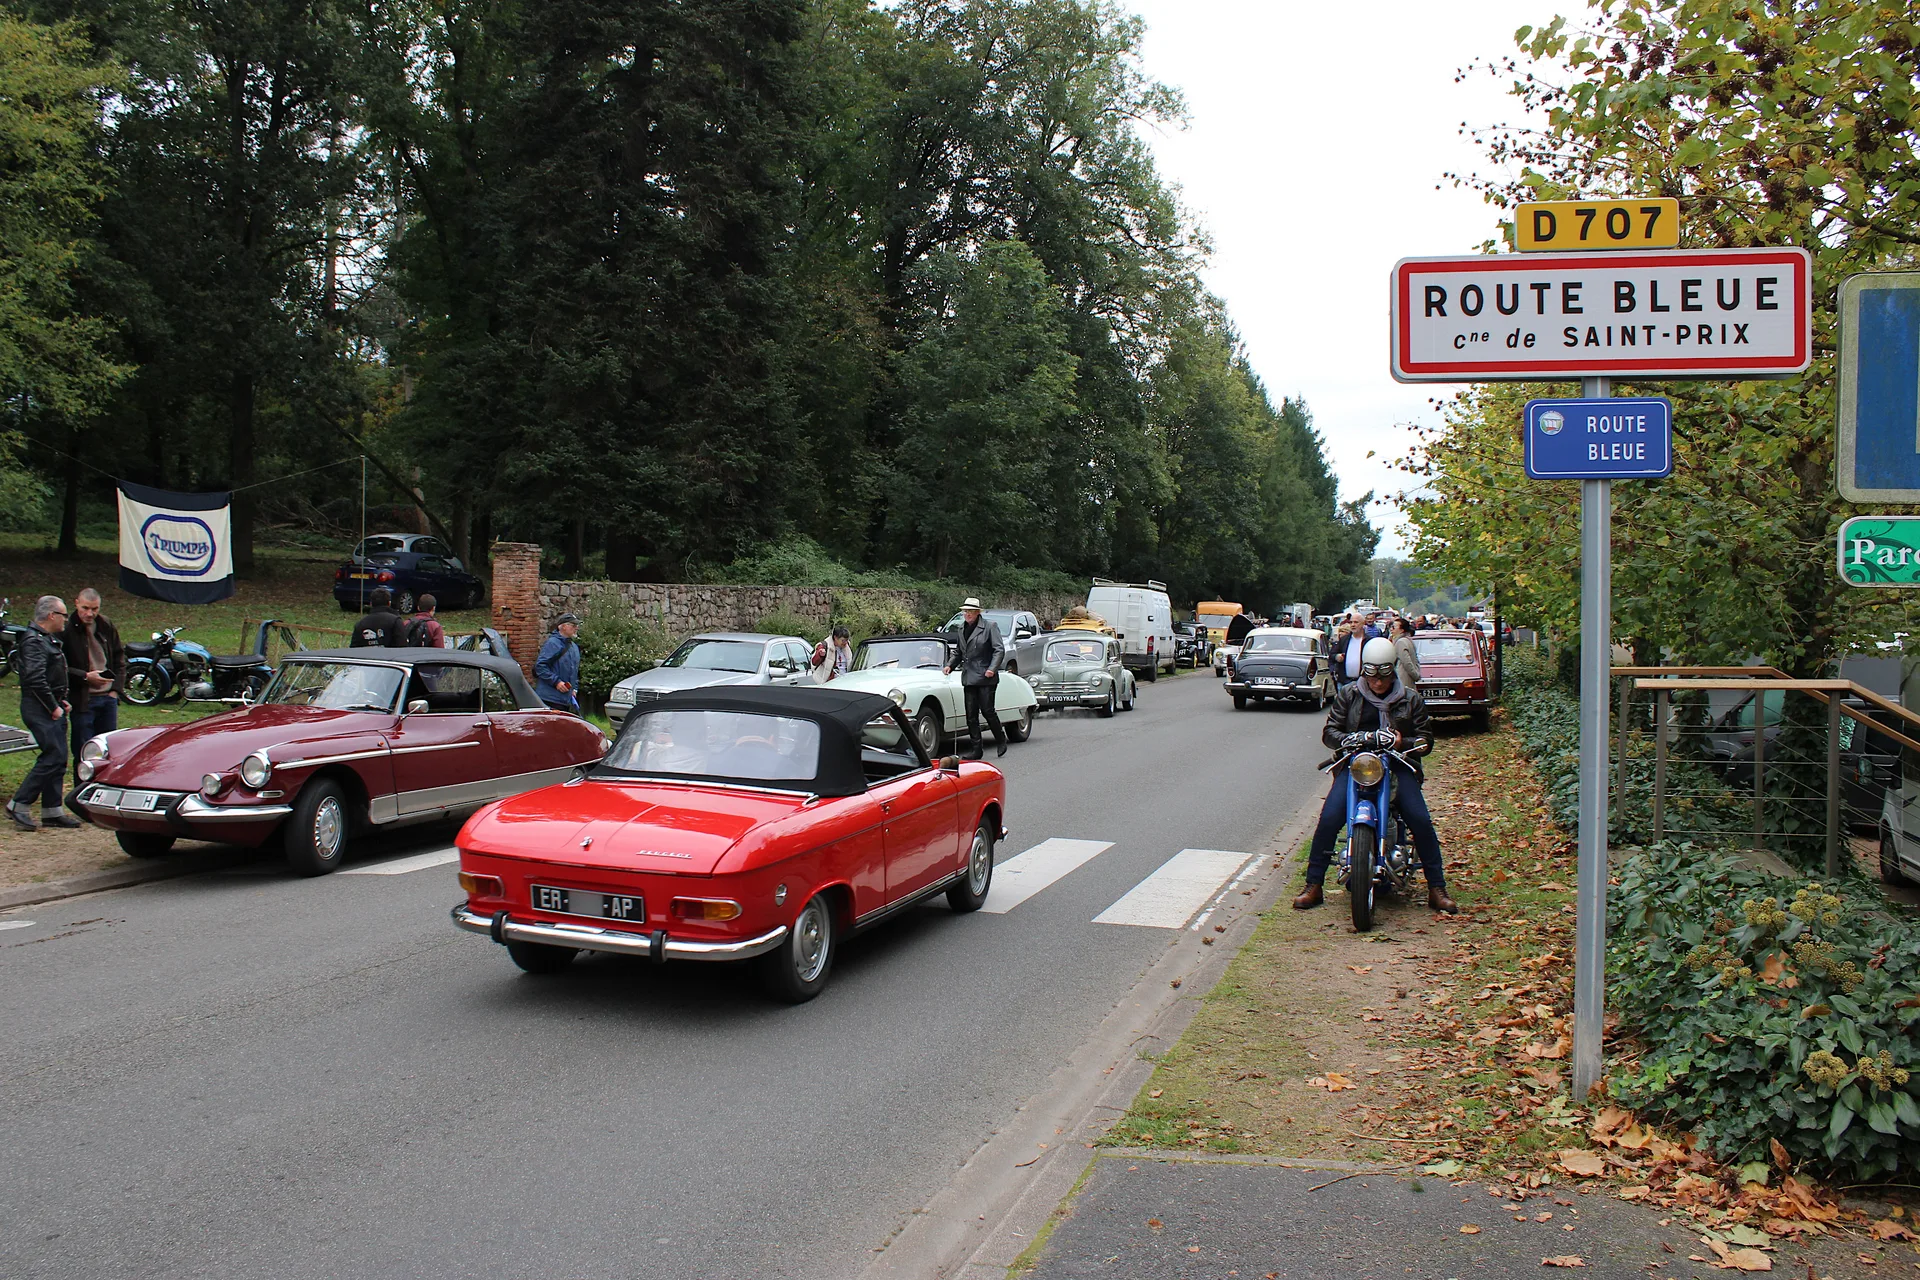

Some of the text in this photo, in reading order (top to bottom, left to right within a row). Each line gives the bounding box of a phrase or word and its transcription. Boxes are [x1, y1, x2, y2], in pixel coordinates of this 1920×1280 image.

[1533, 206, 1662, 242] D 707
[1424, 277, 1779, 318] ROUTE BLEUE
[1506, 327, 1536, 349] de
[1562, 323, 1750, 348] SAINT-PRIX
[1586, 415, 1647, 434] ROUTE
[1587, 443, 1646, 461] BLEUE
